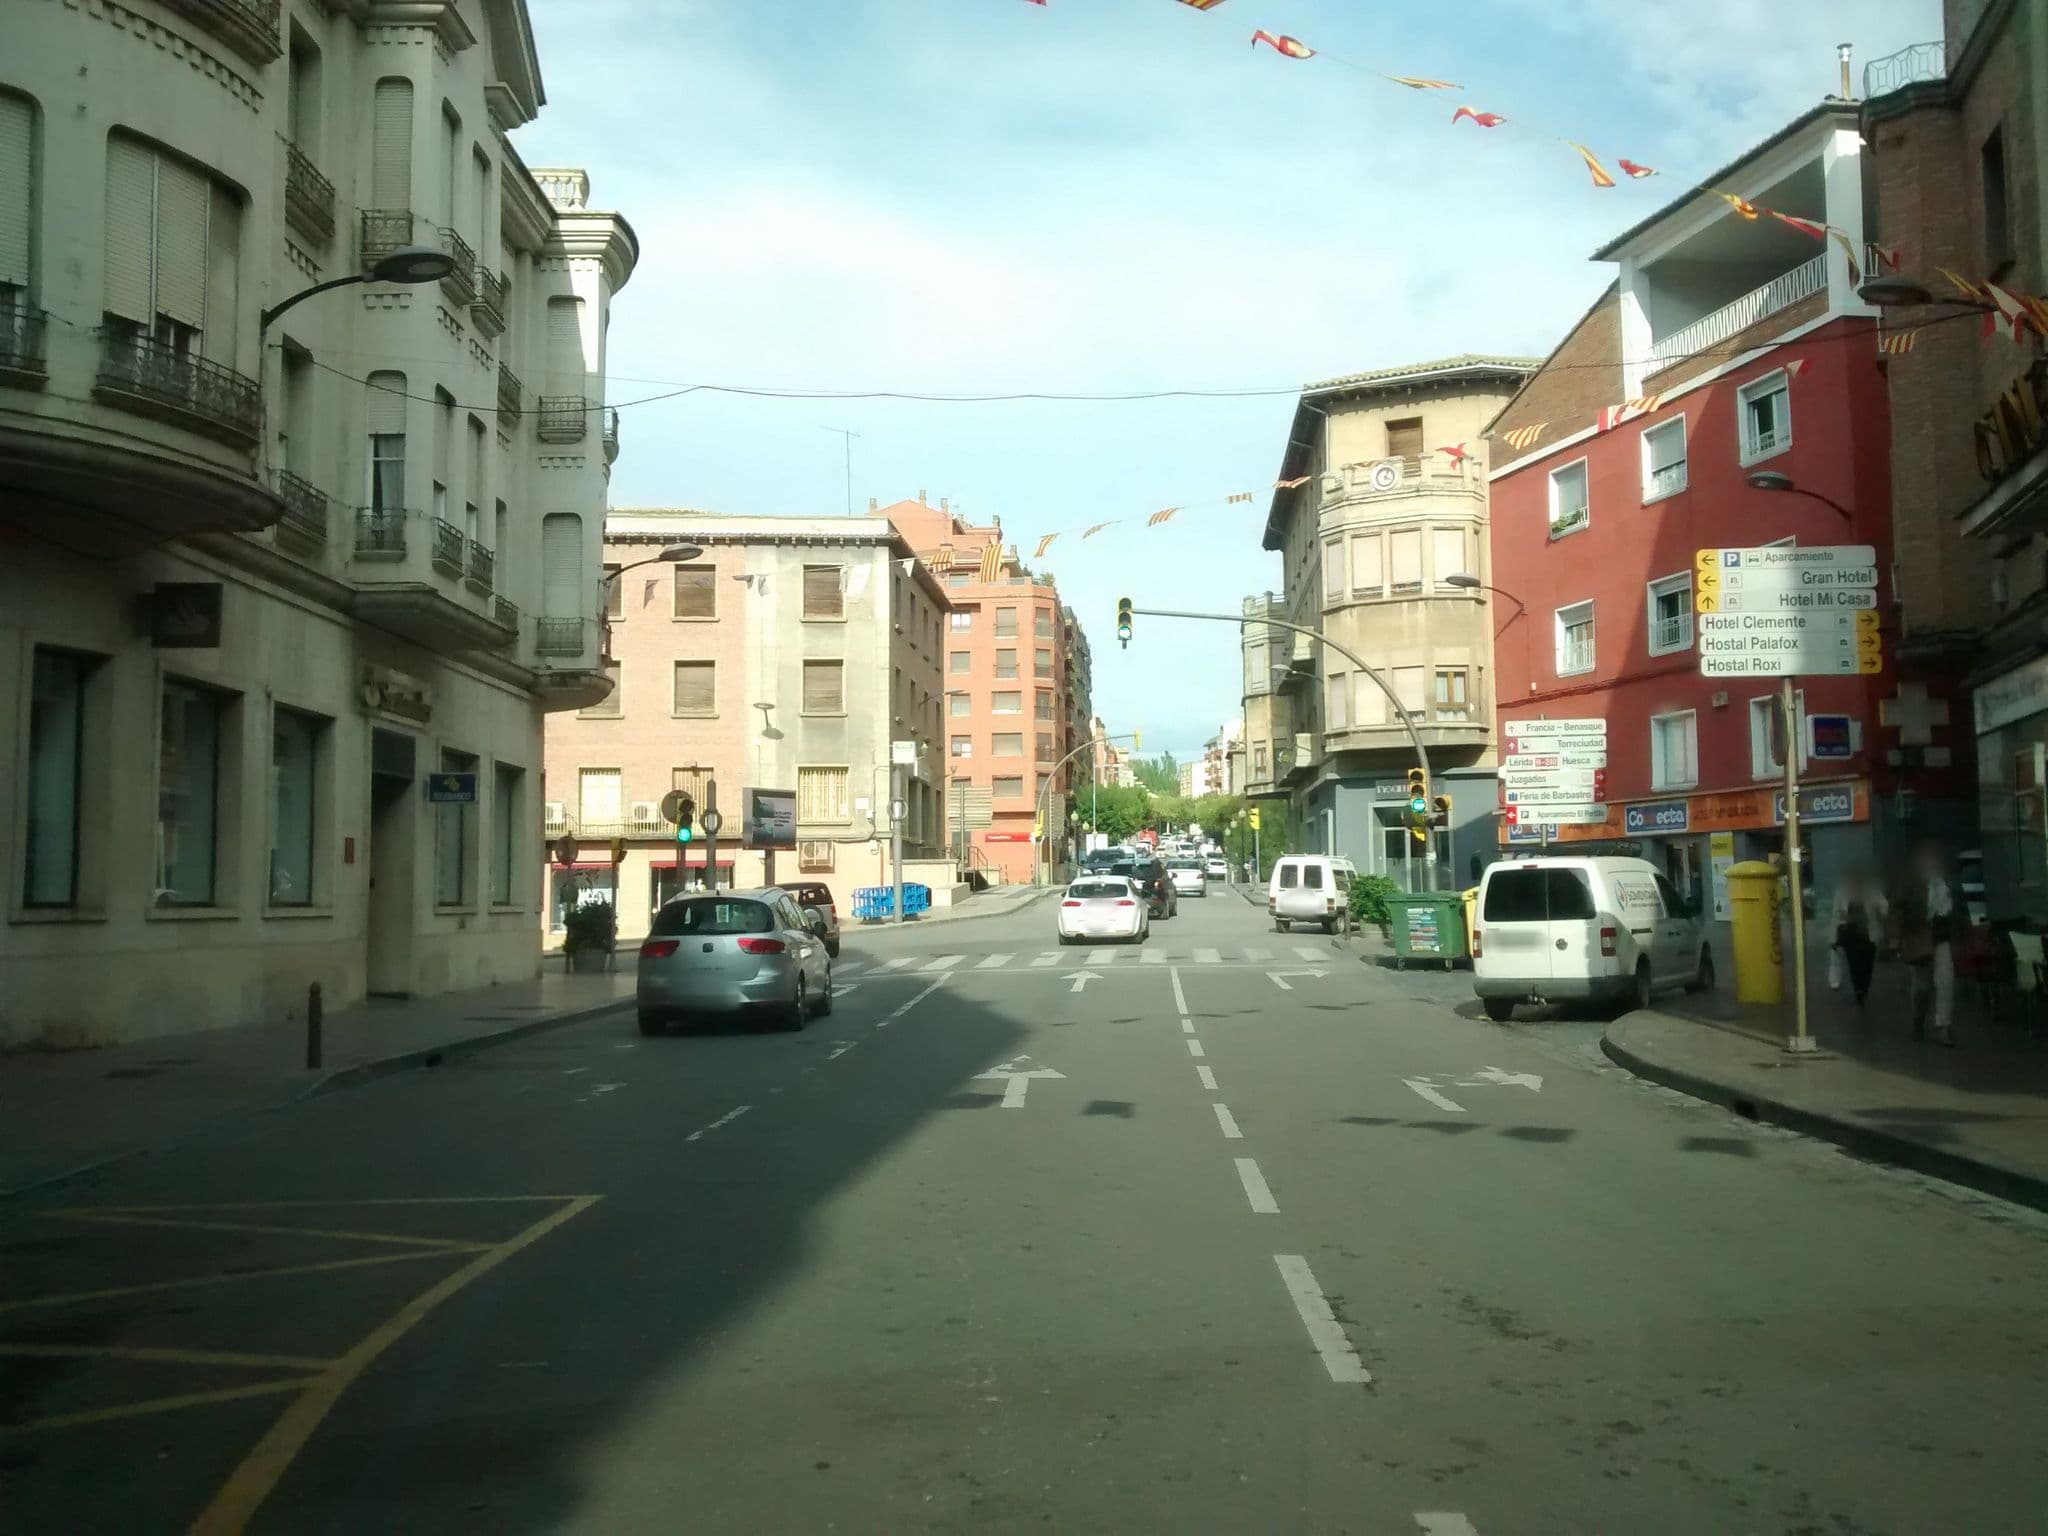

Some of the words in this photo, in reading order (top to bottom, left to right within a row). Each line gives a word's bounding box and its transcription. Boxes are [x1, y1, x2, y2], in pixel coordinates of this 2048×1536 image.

[1765, 551, 1834, 563] Aparcamiento
[1801, 570, 1834, 585] Gran
[1837, 569, 1873, 584] Hotel
[1779, 593, 1813, 607] Hotel
[1817, 592, 1834, 606] Mi
[1836, 591, 1871, 606] Casa
[1705, 616, 1740, 630] Hotel
[1743, 614, 1807, 629] Clemente
[1705, 637, 1747, 651] Hostal
[1750, 635, 1799, 650] Palafox
[1706, 658, 1749, 672] Hostal
[1752, 657, 1782, 671] Roxi
[1526, 723, 1555, 732] Francia
[1564, 722, 1603, 732] Benasque
[1557, 738, 1604, 748] Torreciudad
[1562, 756, 1591, 765] Huesca
[1509, 775, 1547, 785] Juzgados
[1519, 792, 1539, 801] Feria
[1543, 791, 1551, 800] de
[1552, 789, 1592, 800] Barbastro
[1628, 807, 1685, 827] Coecta
